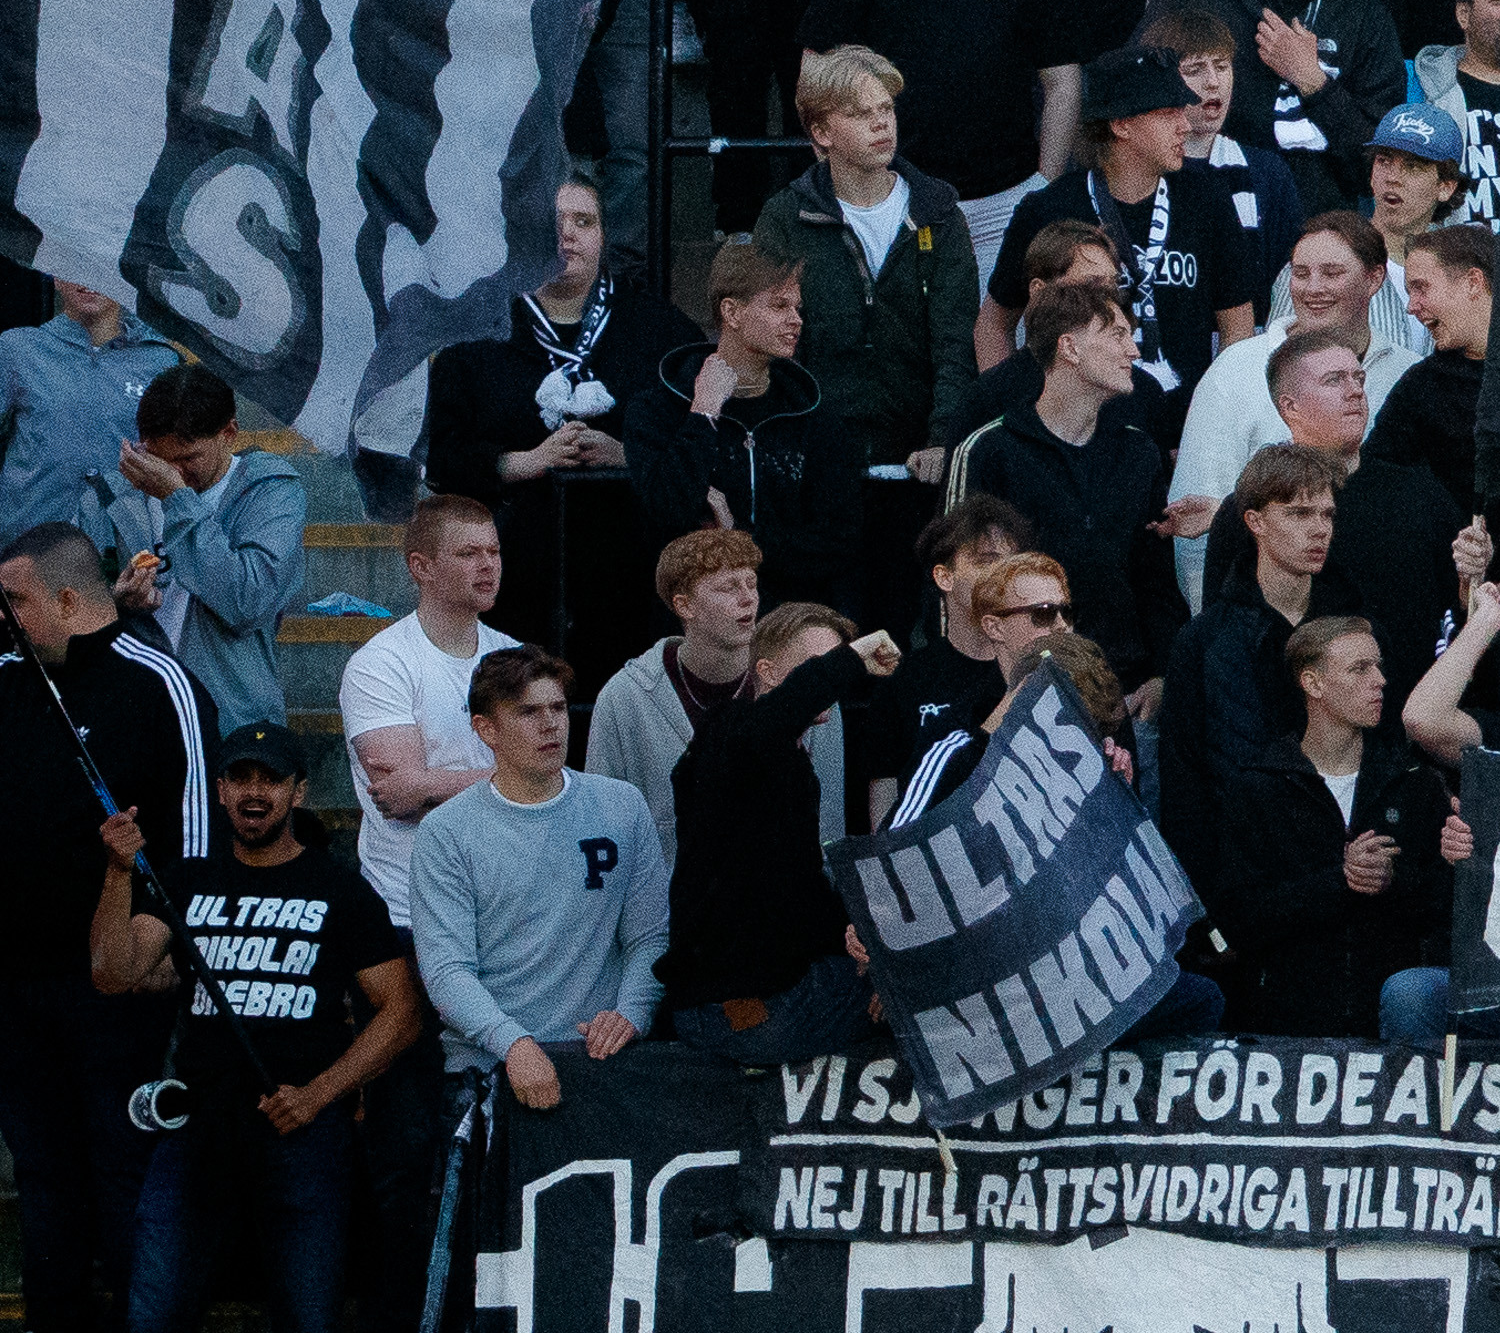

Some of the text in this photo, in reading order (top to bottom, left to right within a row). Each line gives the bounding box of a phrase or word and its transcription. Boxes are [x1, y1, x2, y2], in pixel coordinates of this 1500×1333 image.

[855, 684, 1108, 951] ULTRAS
[577, 837, 619, 891] P
[186, 894, 329, 932] ULTRAS
[914, 820, 1193, 1101] NIKOLAI
[191, 980, 318, 1020] ÖEBRO
[782, 1057, 846, 1124] VI
[1156, 1040, 1283, 1125] FÖR
[1296, 1052, 1382, 1126] DE
[774, 1166, 867, 1231] NEJ
[878, 1168, 968, 1233] TILL
[977, 1158, 1311, 1232] RÄTTSVIDRIGA
